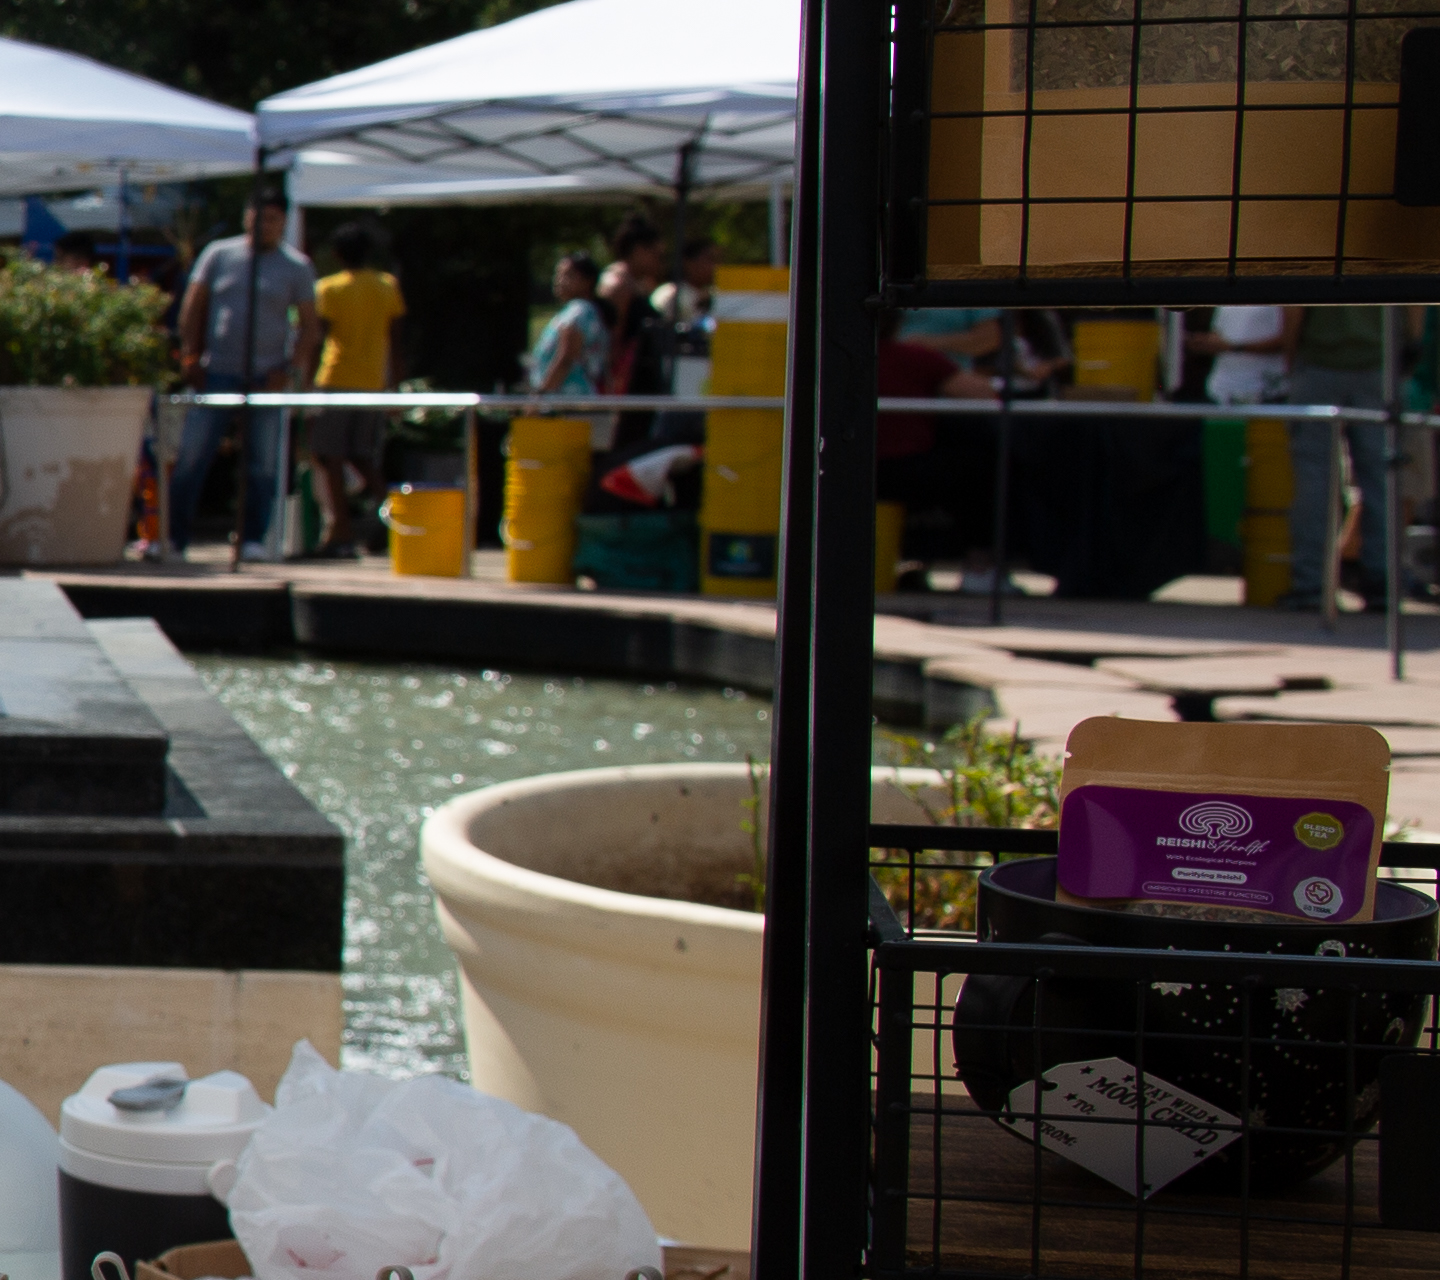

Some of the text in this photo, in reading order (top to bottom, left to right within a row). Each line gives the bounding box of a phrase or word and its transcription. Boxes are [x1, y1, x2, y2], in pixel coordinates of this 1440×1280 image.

[1072, 1099, 1096, 1115] TO:
[1132, 1079, 1208, 1119] TAY WILD
